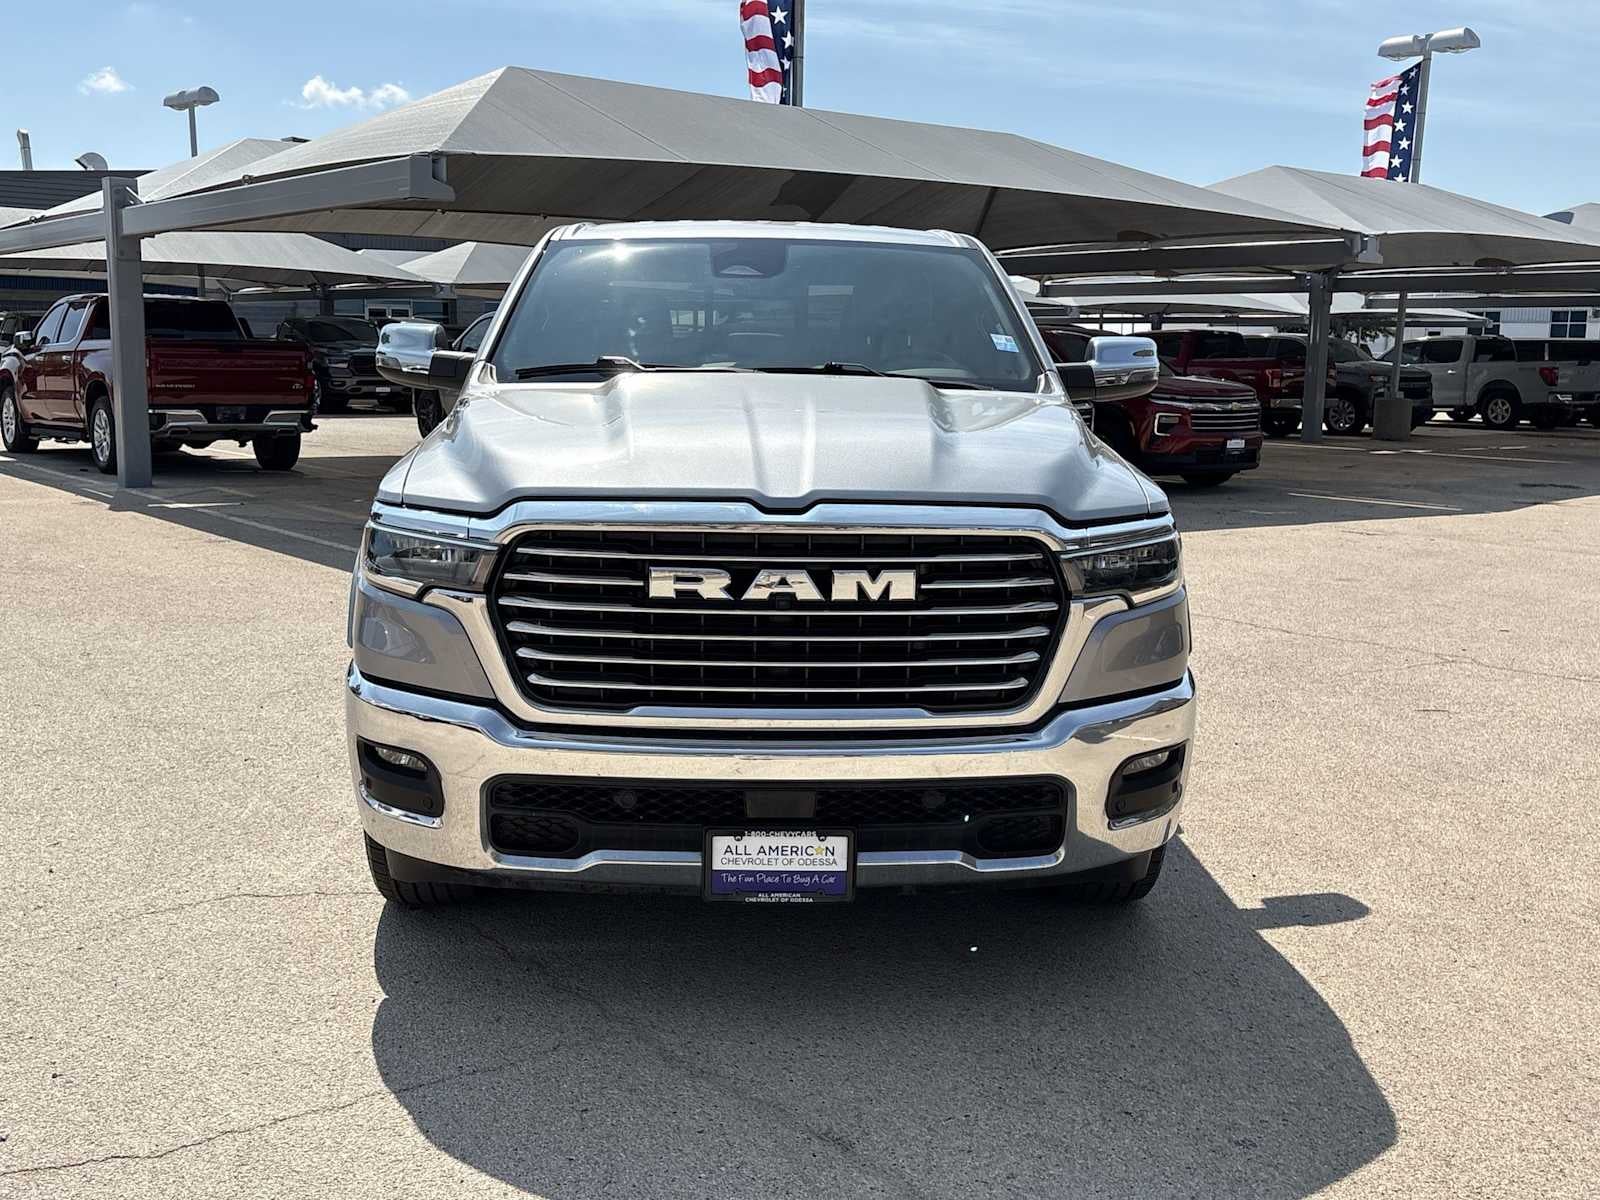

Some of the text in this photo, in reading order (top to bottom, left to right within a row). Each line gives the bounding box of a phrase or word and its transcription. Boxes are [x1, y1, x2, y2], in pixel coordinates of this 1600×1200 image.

[650, 567, 917, 601] RAM
[723, 844, 835, 857] ALL AMERICN
[720, 857, 838, 866] CHEVROLET OF ODESSA
[720, 872, 836, 887] The Fun Place To Buy A Car
